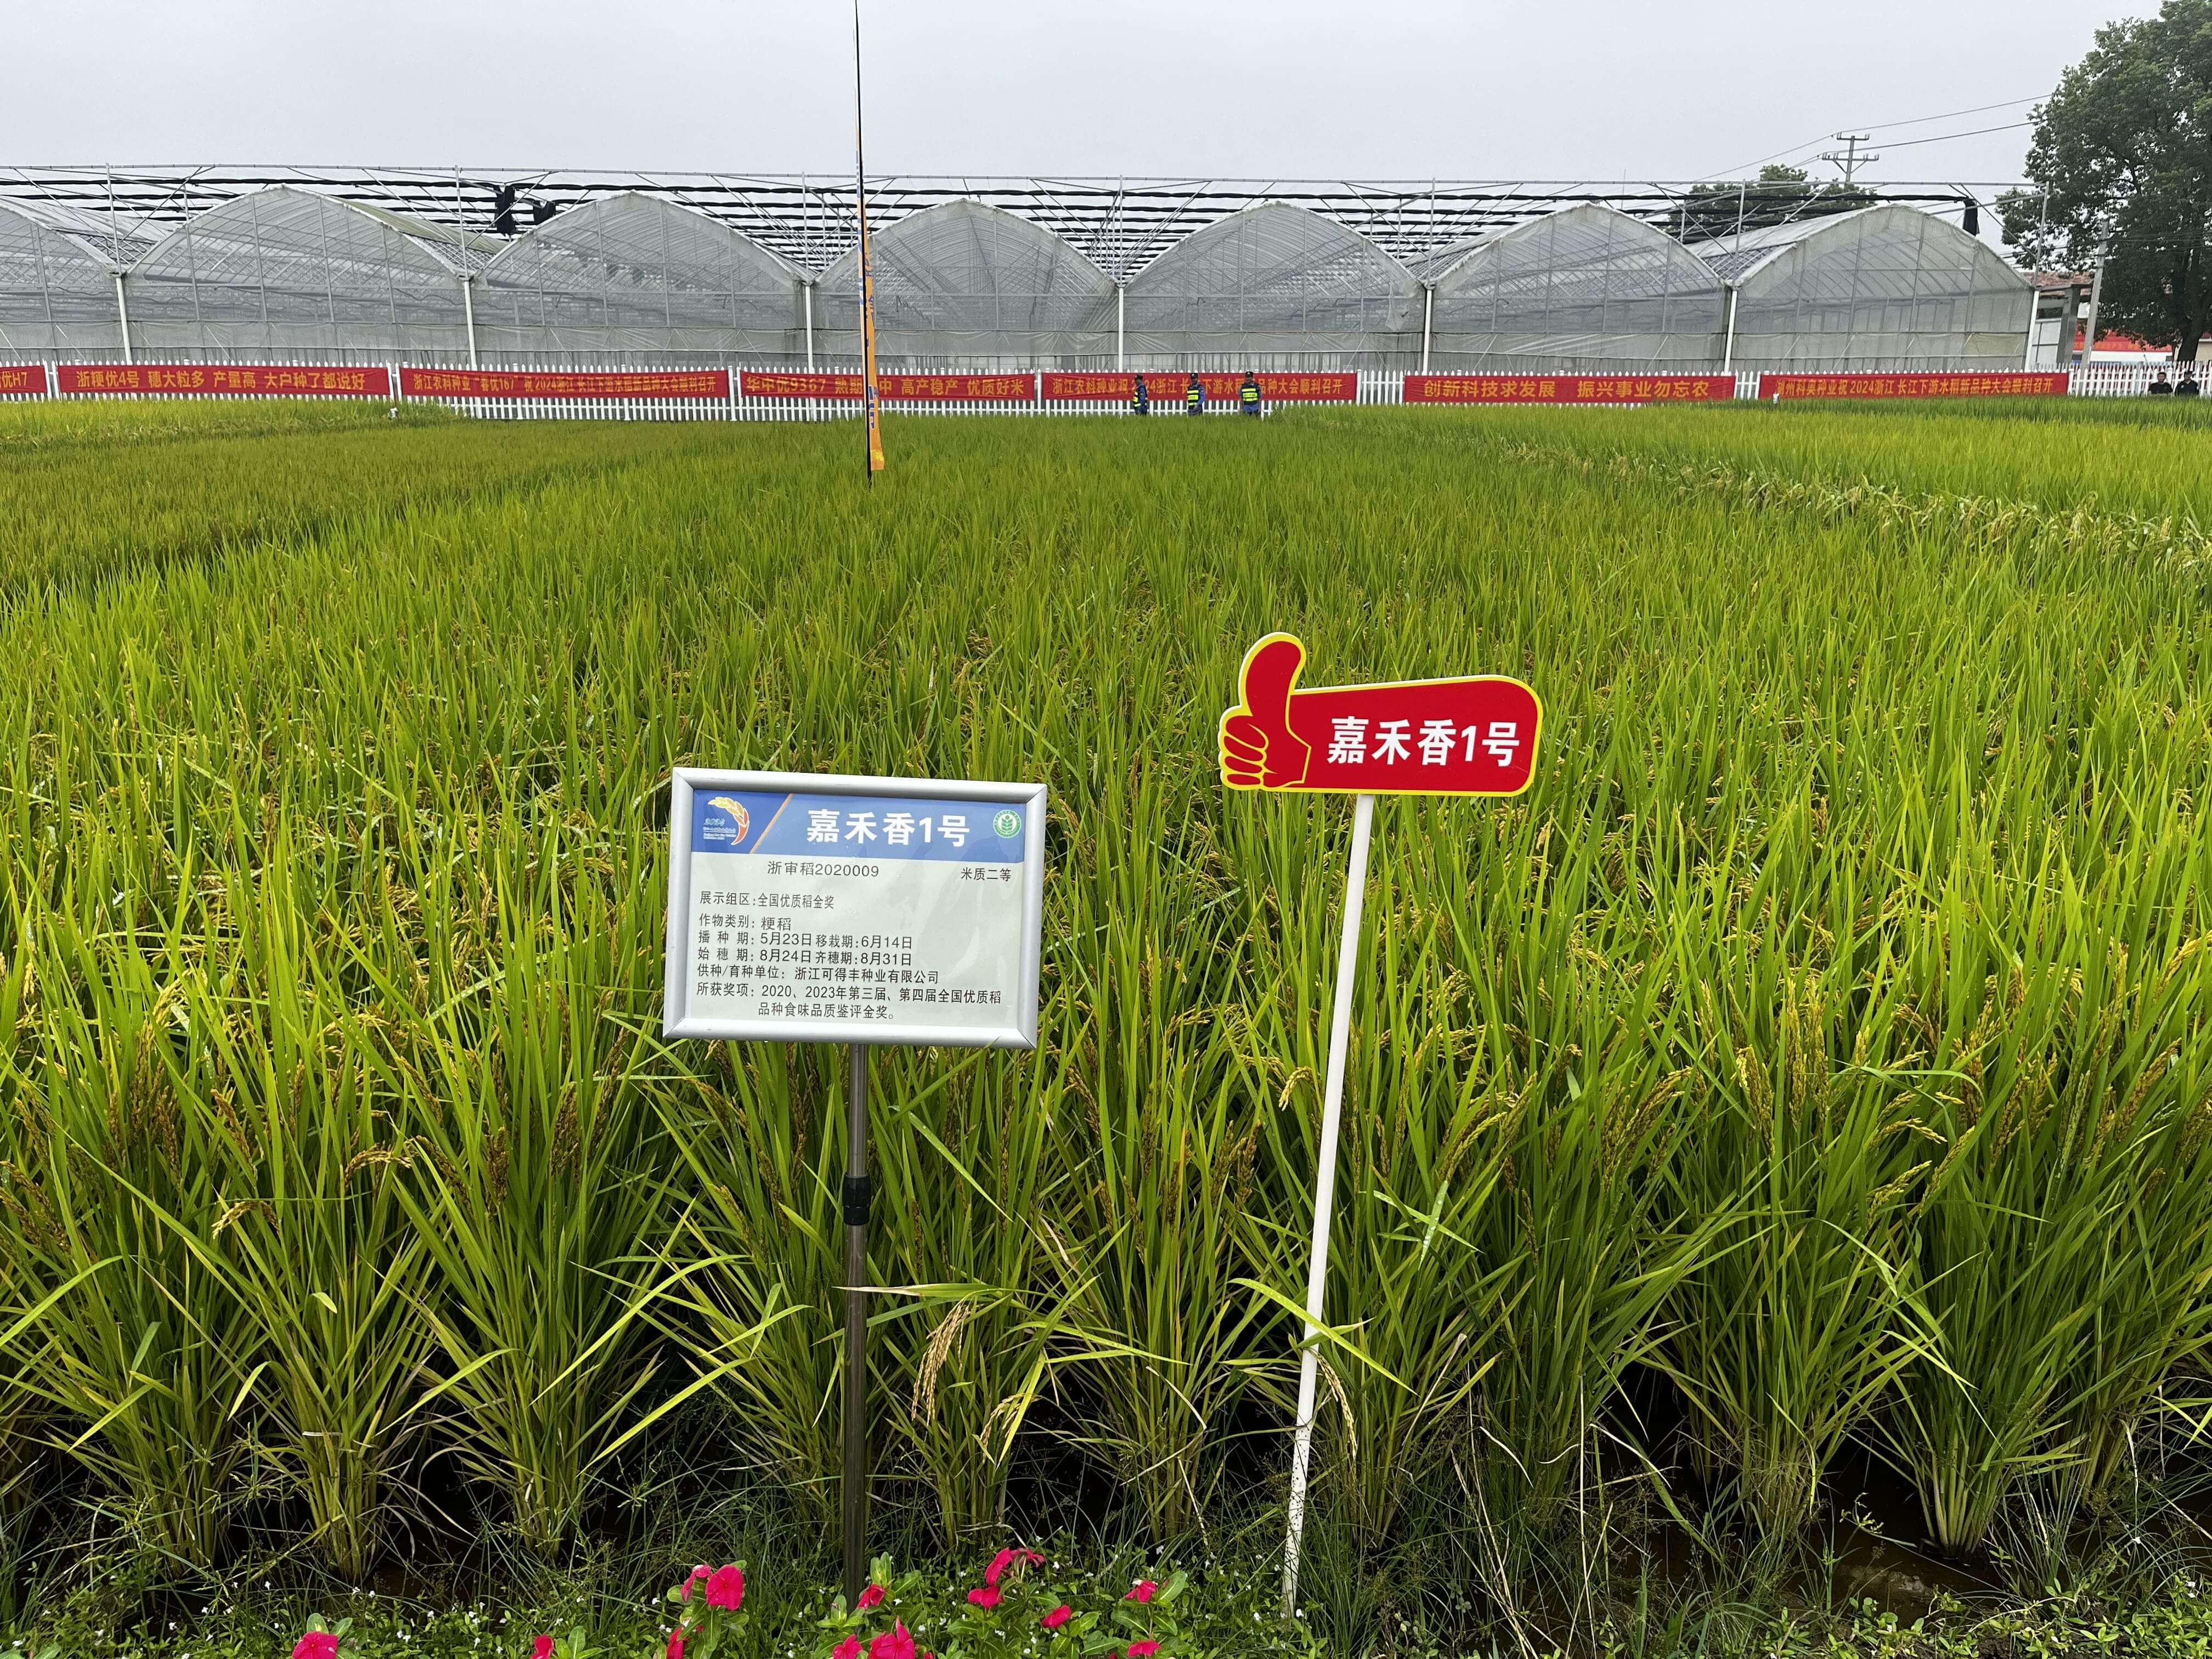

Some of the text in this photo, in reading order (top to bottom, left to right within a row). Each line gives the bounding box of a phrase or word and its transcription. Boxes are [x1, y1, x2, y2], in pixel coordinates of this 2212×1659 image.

[0, 371, 27, 388] 优H7
[77, 370, 365, 390] 浙粳优4号 穗大粒多 产量高 大户种了都说好
[746, 375, 826, 392] 华中优9367
[901, 378, 958, 396] 高产稳产
[967, 379, 1024, 396] 优质好米
[1424, 380, 1709, 398] 创新科技求发展 振兴事业勿忘农
[1327, 715, 1520, 767] 嘉禾香1号
[806, 809, 970, 847] 嘉禾香1号
[767, 860, 879, 877] 浙审稻2020009
[961, 867, 1012, 882] 米质二等
[758, 1001, 894, 1020] 品种食味品质鉴评金奖。
